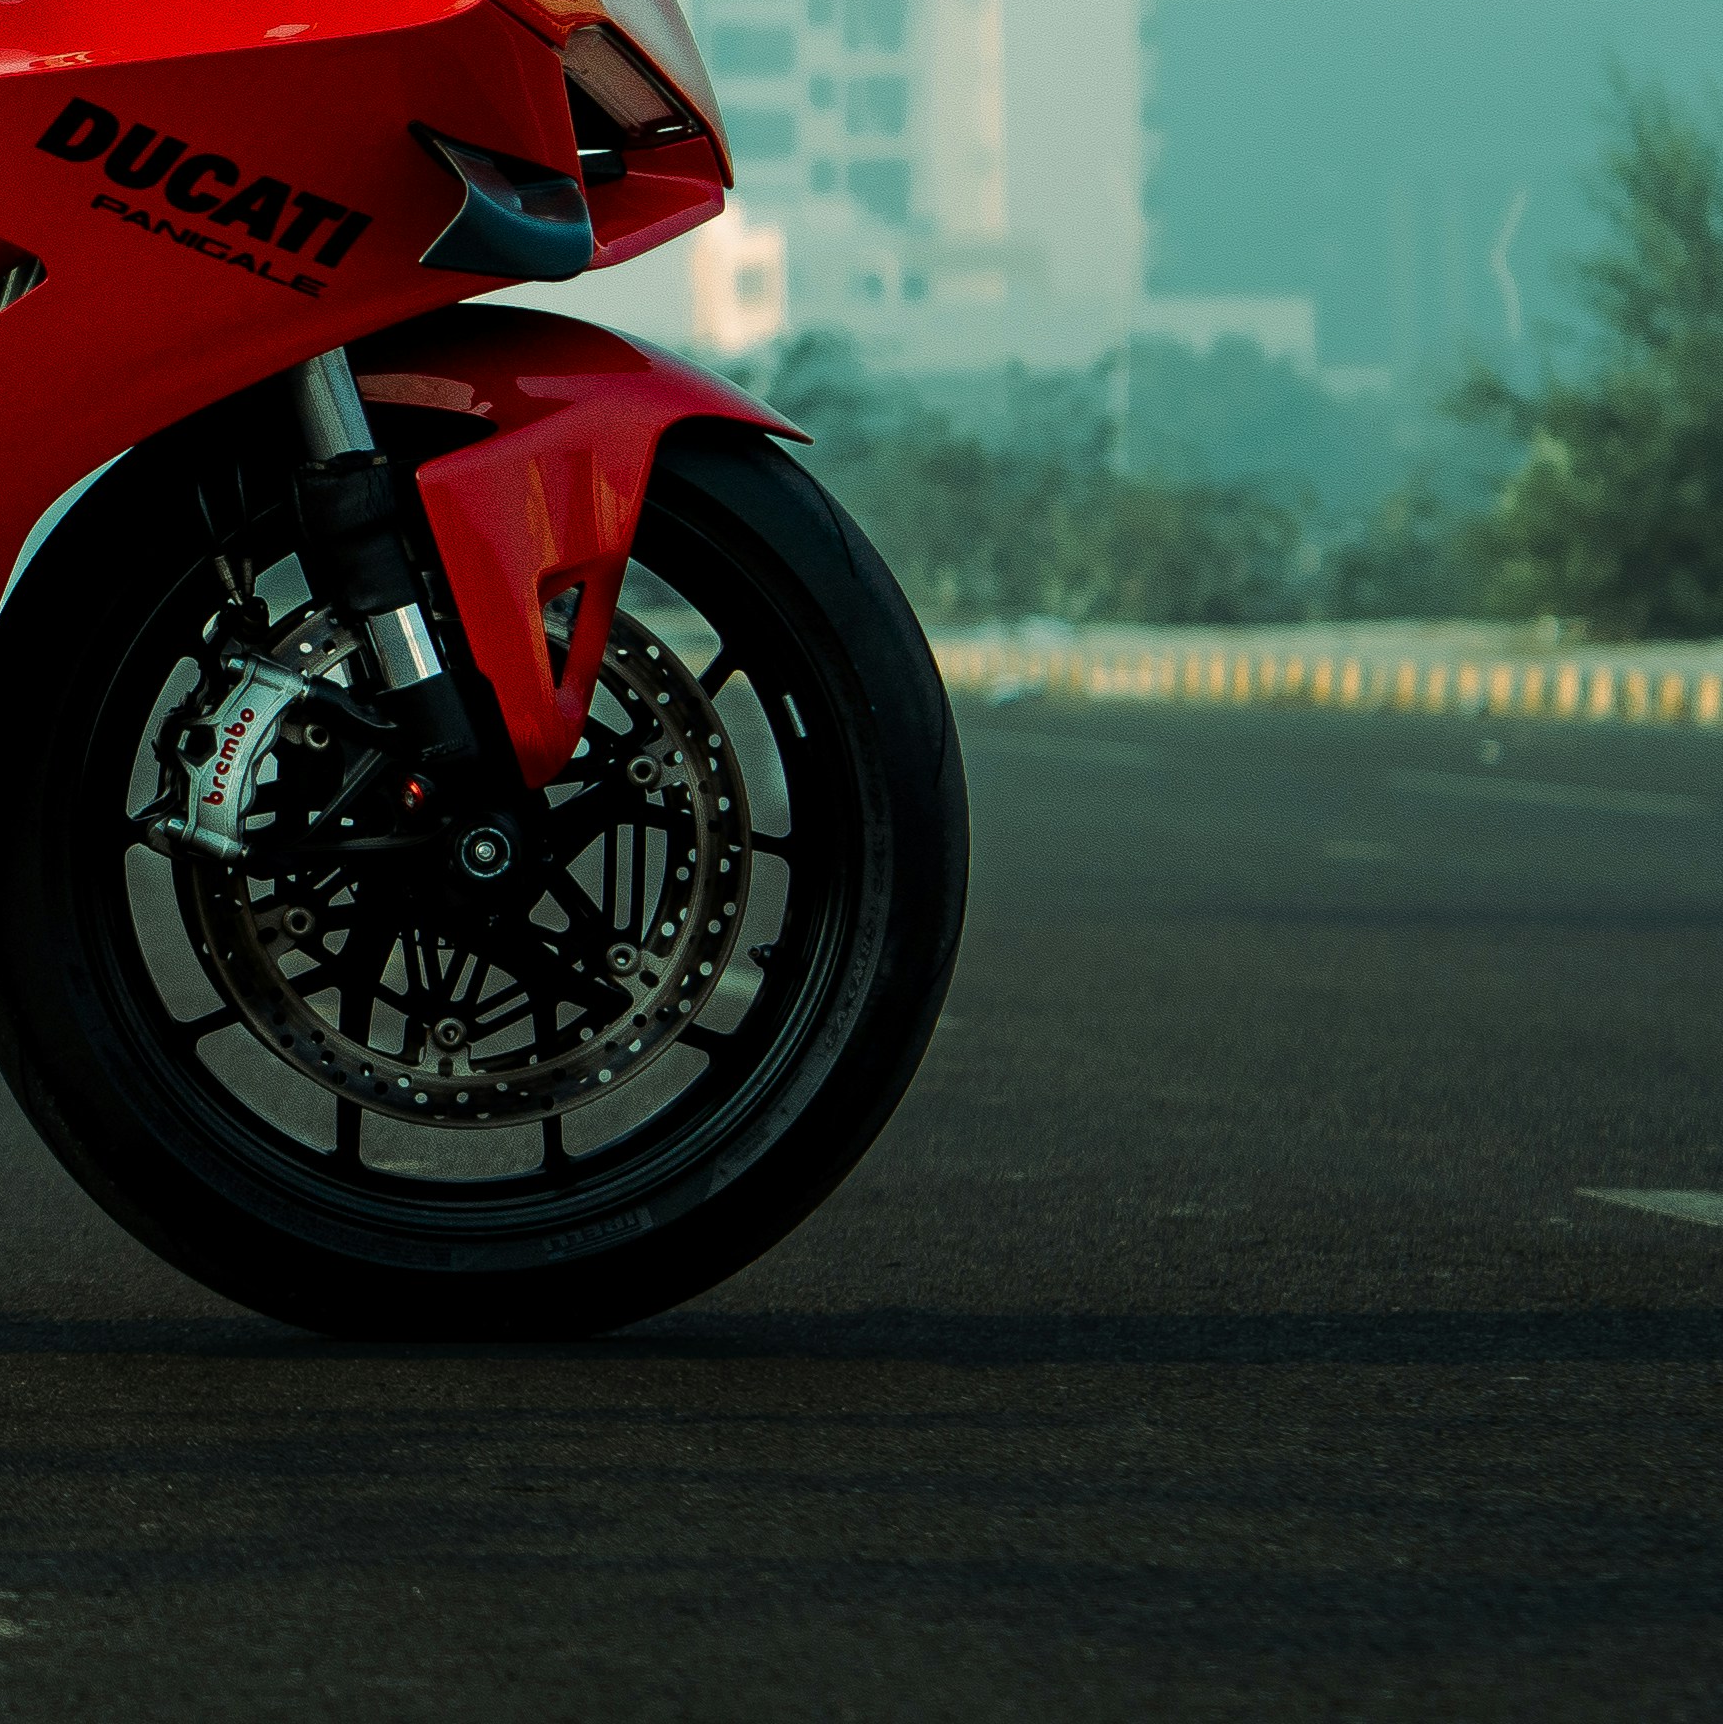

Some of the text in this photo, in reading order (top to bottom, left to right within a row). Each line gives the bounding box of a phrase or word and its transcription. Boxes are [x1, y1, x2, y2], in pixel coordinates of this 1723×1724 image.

[35, 96, 372, 270] DUCATI
[90, 193, 330, 298] PANIGALE
[202, 707, 255, 806] brembo
